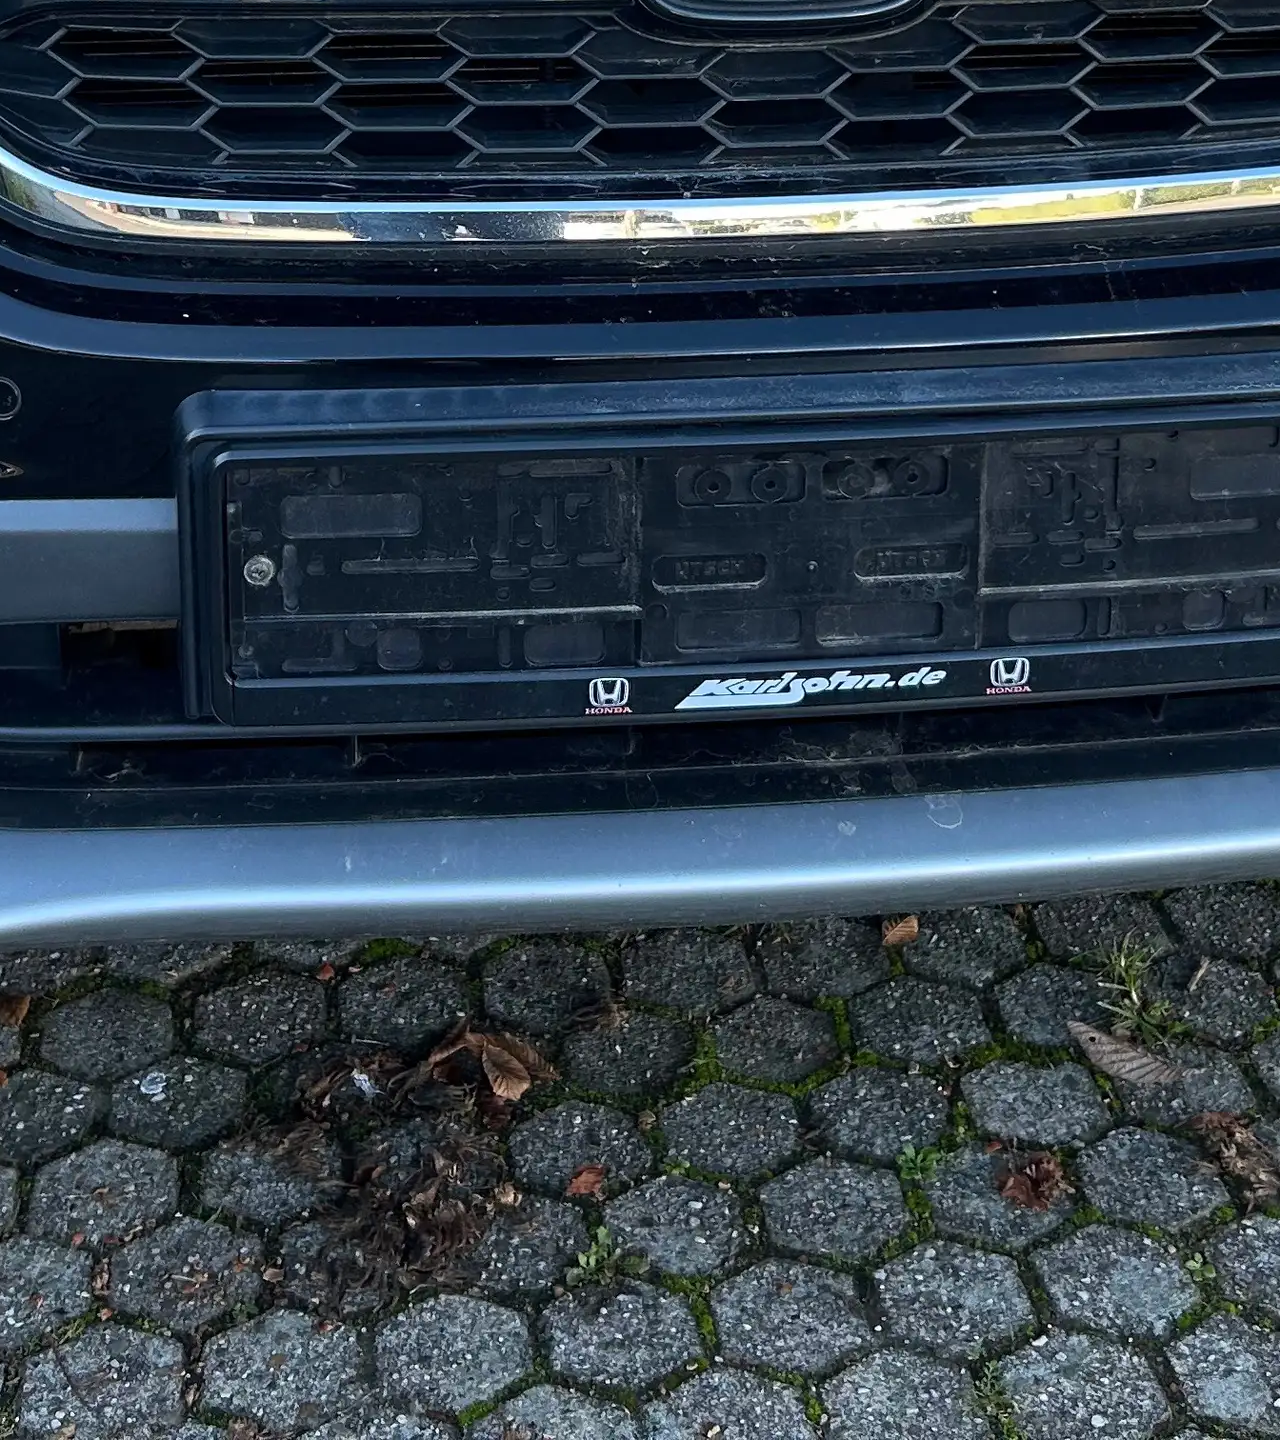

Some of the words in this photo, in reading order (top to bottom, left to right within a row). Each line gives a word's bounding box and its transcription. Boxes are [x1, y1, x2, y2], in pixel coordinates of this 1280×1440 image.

[674, 666, 947, 710] Karlsohn.de
[985, 685, 1032, 695] HONDA
[585, 706, 633, 715] HONDA
